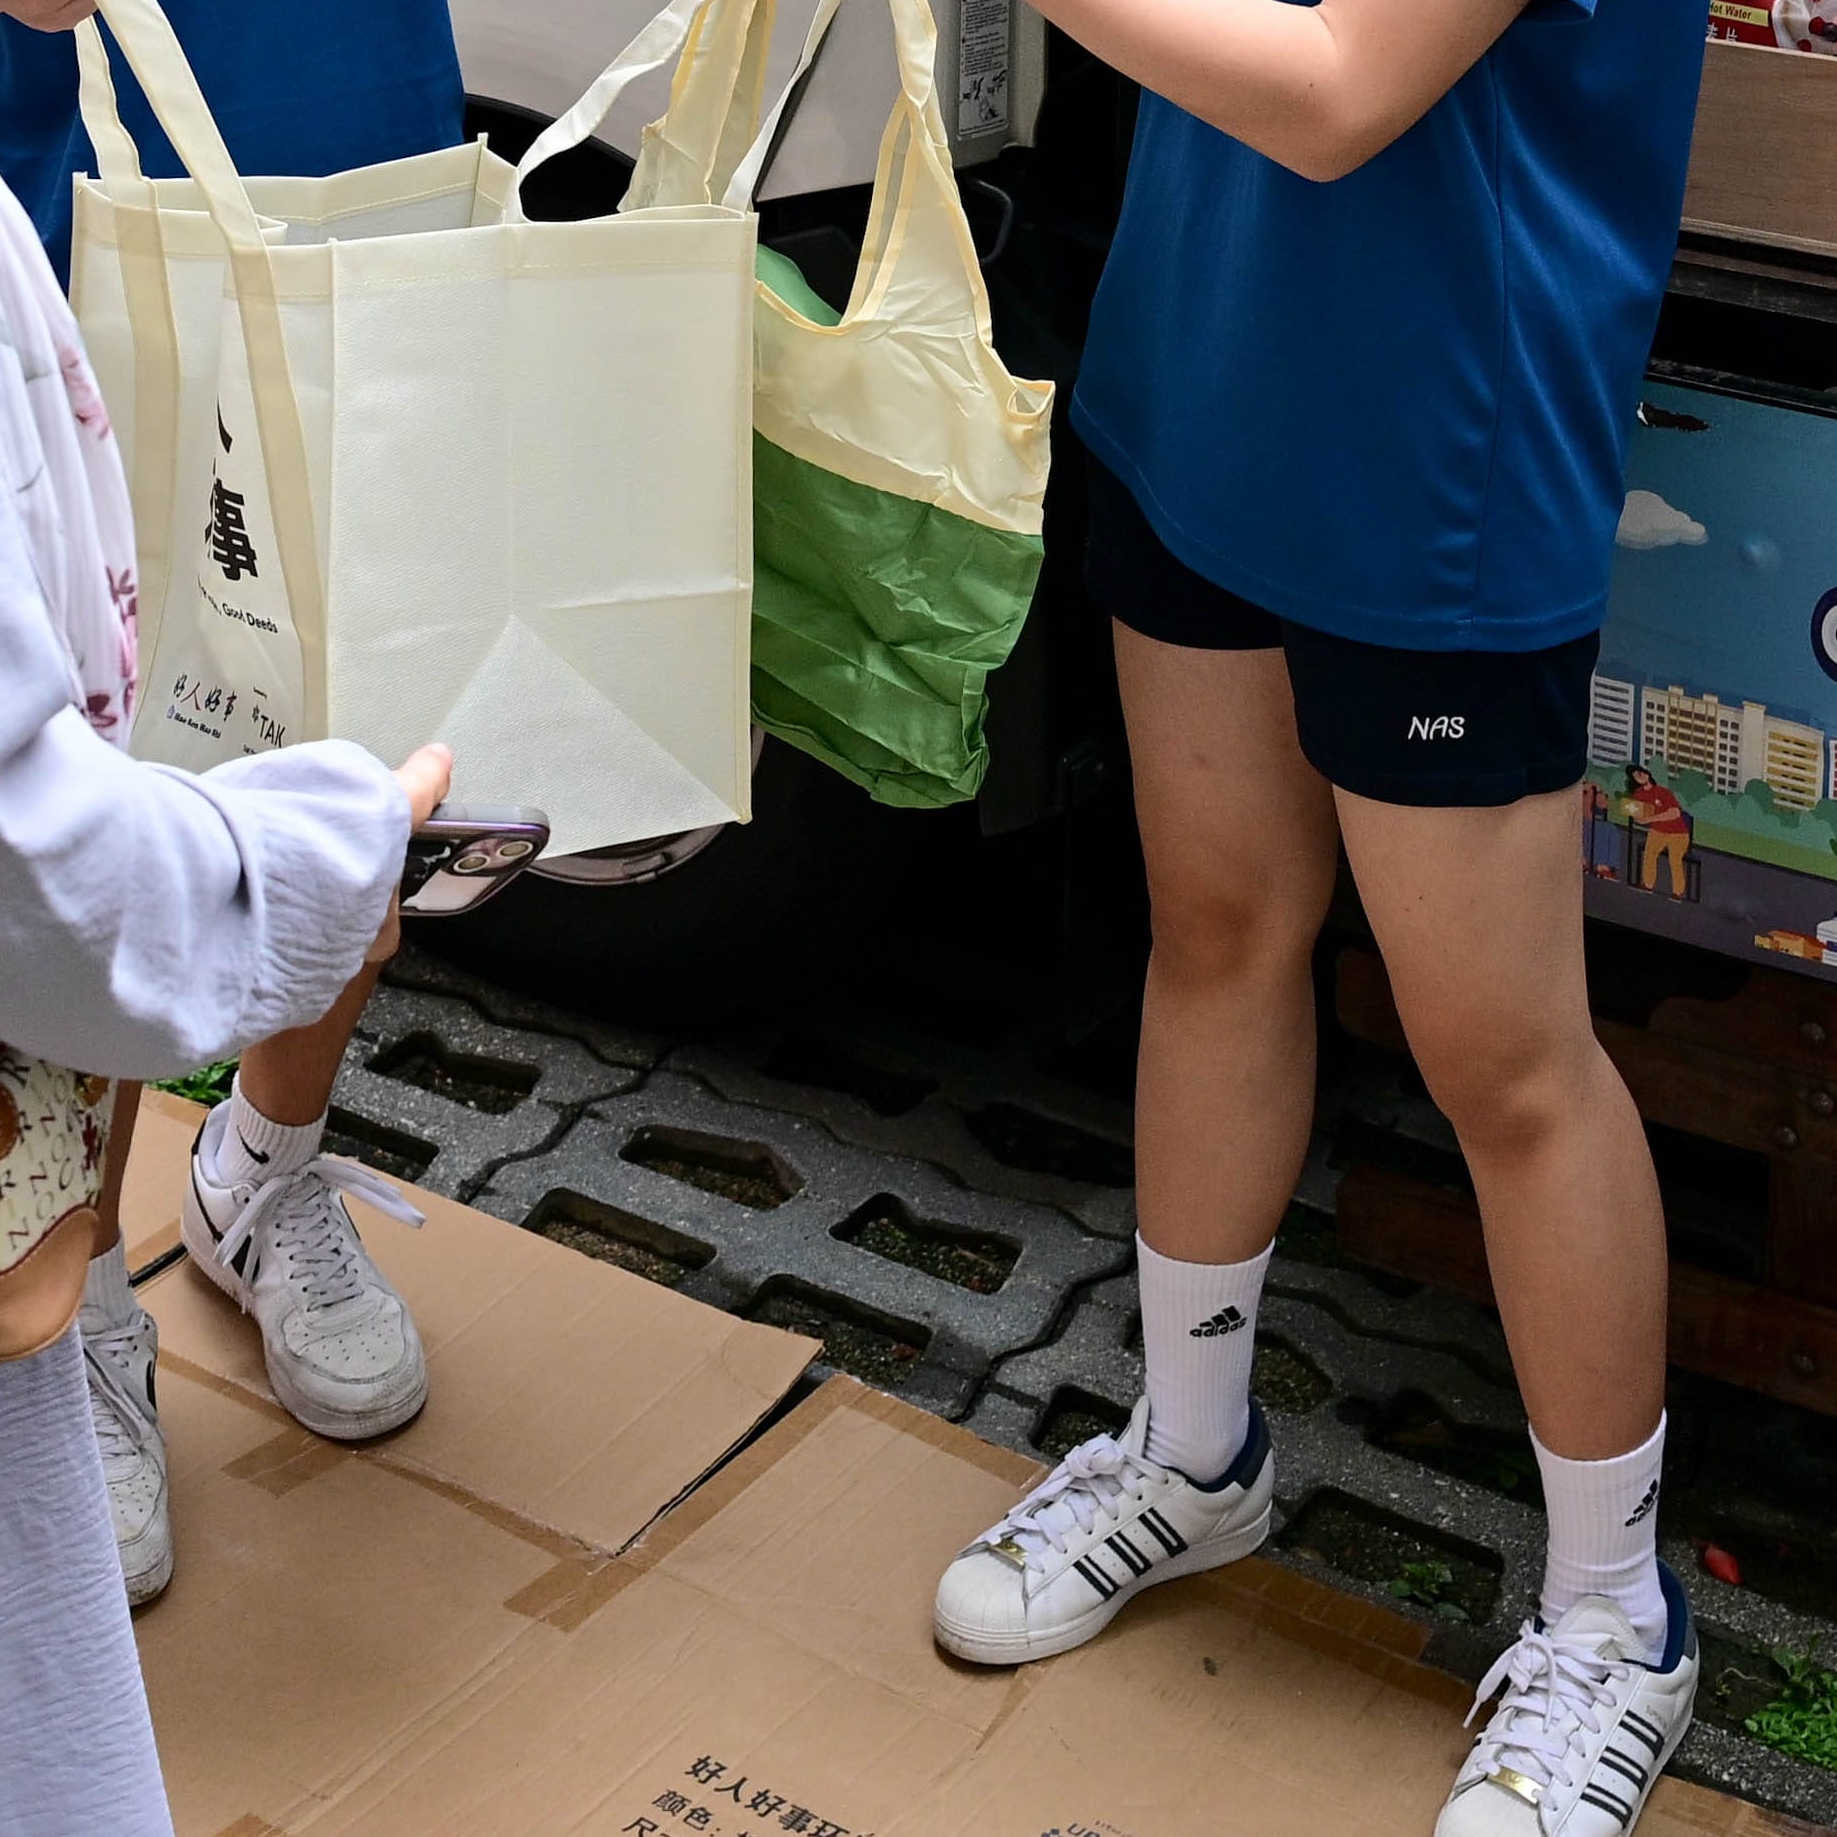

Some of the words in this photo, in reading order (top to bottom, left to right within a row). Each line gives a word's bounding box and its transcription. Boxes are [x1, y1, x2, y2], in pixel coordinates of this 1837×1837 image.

[1725, 4, 1753, 20] Water
[246, 611, 278, 634] Deeds
[172, 673, 238, 722] 好人好事
[1408, 715, 1465, 741] NAS
[684, 1754, 876, 1837] 好人好事环
